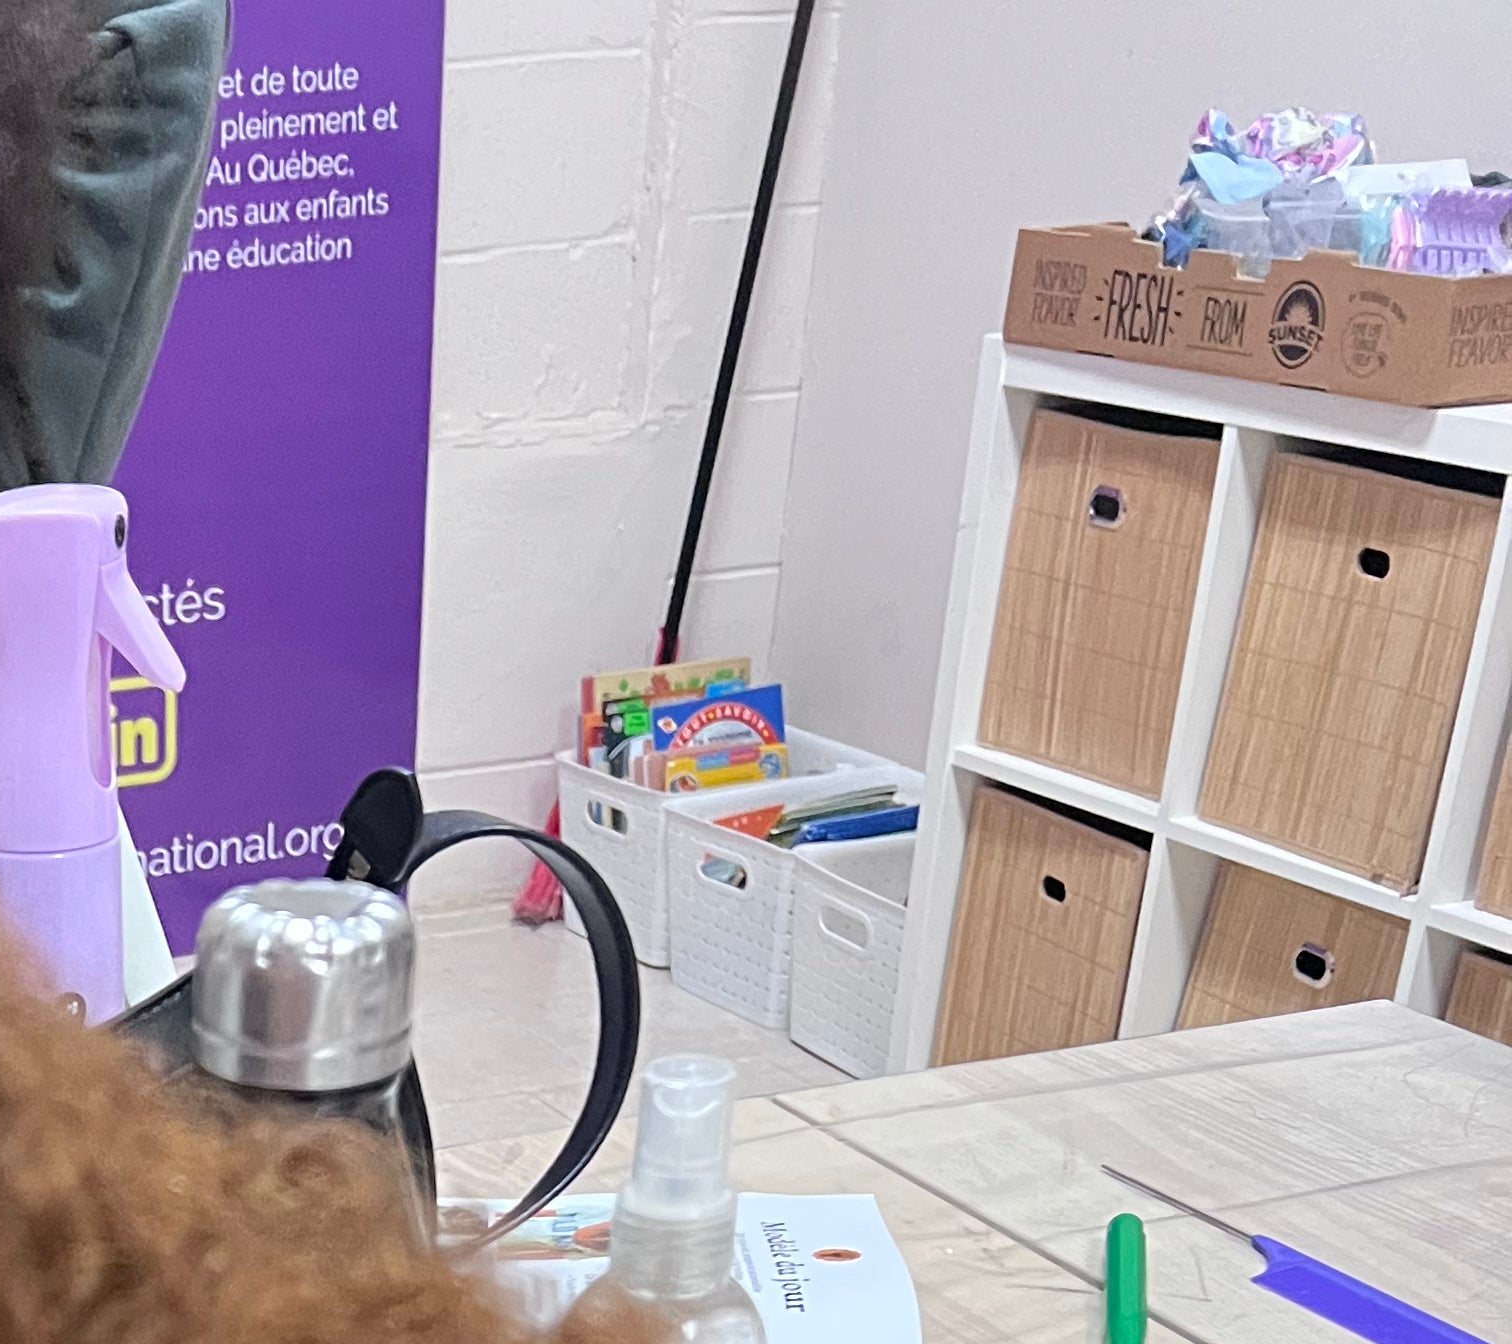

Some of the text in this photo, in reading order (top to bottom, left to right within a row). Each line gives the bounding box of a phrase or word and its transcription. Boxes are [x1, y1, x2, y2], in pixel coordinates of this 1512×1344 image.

[218, 63, 359, 98] et de toute
[221, 101, 399, 149] pleinement et
[206, 149, 355, 186] Au Québec,
[244, 201, 289, 225] aux
[296, 187, 390, 221] enfants
[226, 231, 353, 269] éducation
[1103, 269, 1175, 347] FRESH
[1200, 296, 1248, 348] FROM
[1268, 323, 1325, 353] SUNSET
[774, 1260, 805, 1275] du
[770, 1277, 811, 1313] jour
